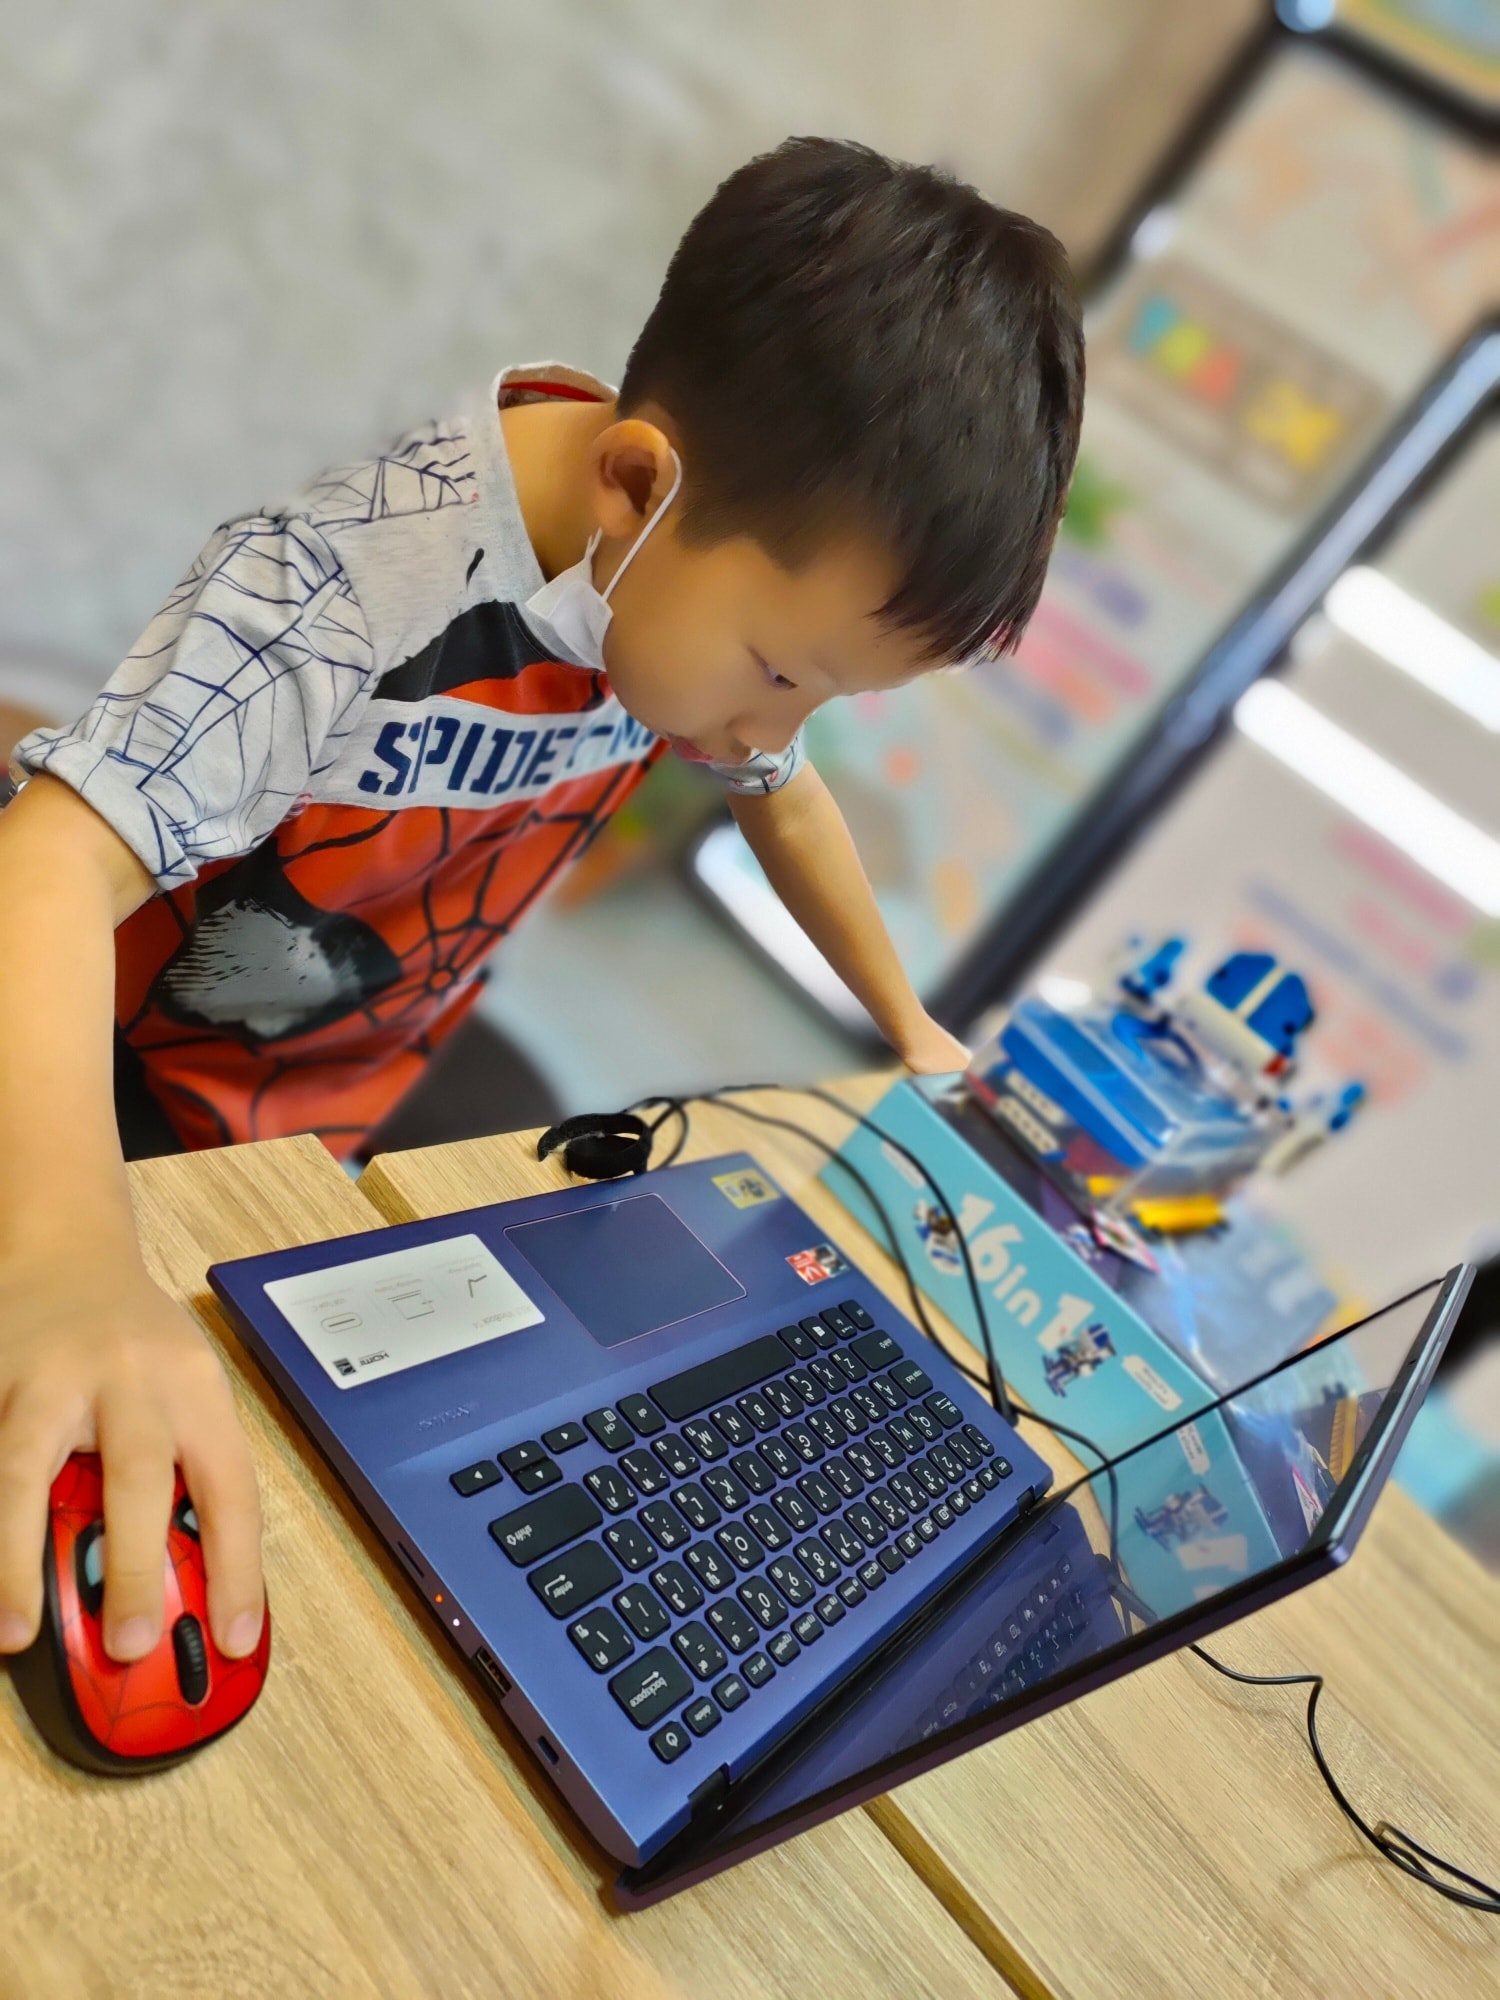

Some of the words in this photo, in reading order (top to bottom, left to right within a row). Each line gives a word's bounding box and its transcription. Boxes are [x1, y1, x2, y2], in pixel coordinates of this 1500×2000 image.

[843, 1357, 855, 1369] Z
[822, 1367, 835, 1380] X
[800, 1379, 813, 1392] C
[882, 1384, 894, 1396] A
[779, 1392, 791, 1404] V
[864, 1396, 876, 1408] S
[637, 1407, 648, 1418] alt
[753, 1403, 766, 1417] B
[843, 1407, 856, 1420] D
[603, 1422, 616, 1435] ctrl
[726, 1416, 741, 1431] N
[824, 1420, 834, 1434] F
[918, 1416, 931, 1428] Q
[697, 1430, 713, 1446] M
[798, 1434, 811, 1448] G
[900, 1427, 914, 1441] W
[880, 1440, 893, 1453] E
[773, 1448, 787, 1463] H
[859, 1454, 872, 1467] R
[748, 1463, 759, 1478] J
[838, 1469, 851, 1482] T
[719, 1478, 734, 1495] K
[815, 1484, 828, 1498] Y
[690, 1496, 704, 1511] L
[789, 1500, 803, 1515] U
[513, 1524, 533, 1542] shift
[733, 1535, 749, 1552] O
[707, 1555, 718, 1572] P
[552, 1580, 574, 1599] enter
[629, 1676, 668, 1708] backspace
